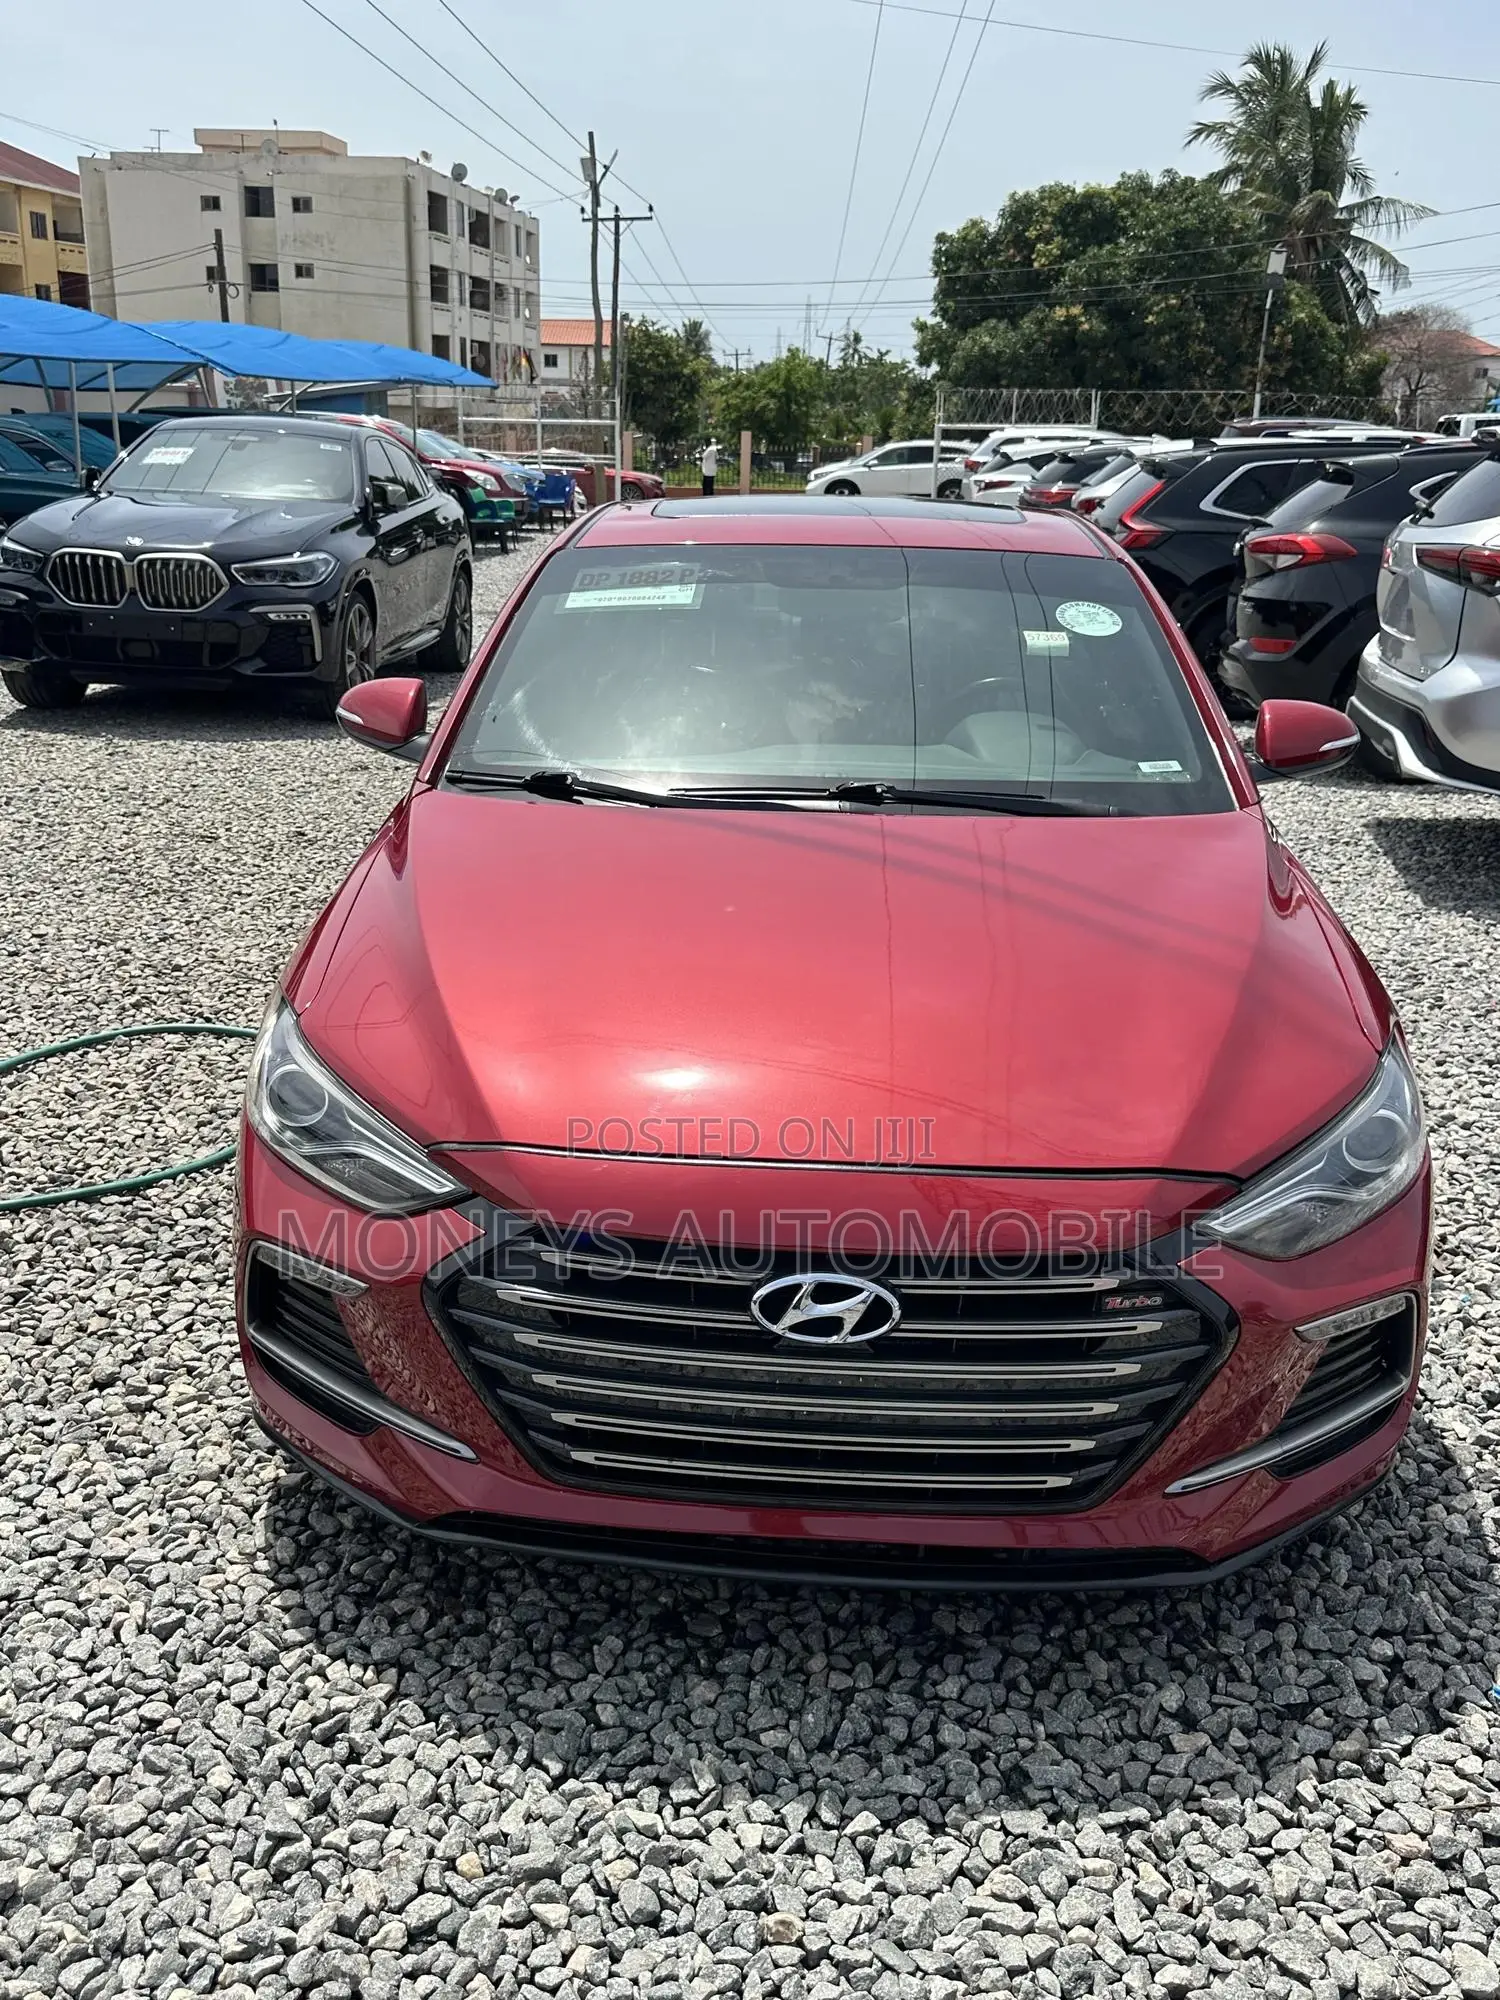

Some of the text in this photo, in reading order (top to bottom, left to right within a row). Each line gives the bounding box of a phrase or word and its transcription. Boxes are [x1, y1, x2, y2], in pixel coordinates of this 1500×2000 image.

[578, 572, 611, 587] DP
[617, 569, 676, 585] 1882
[1026, 633, 1066, 642] 57369
[1104, 1295, 1164, 1310] Turbo
